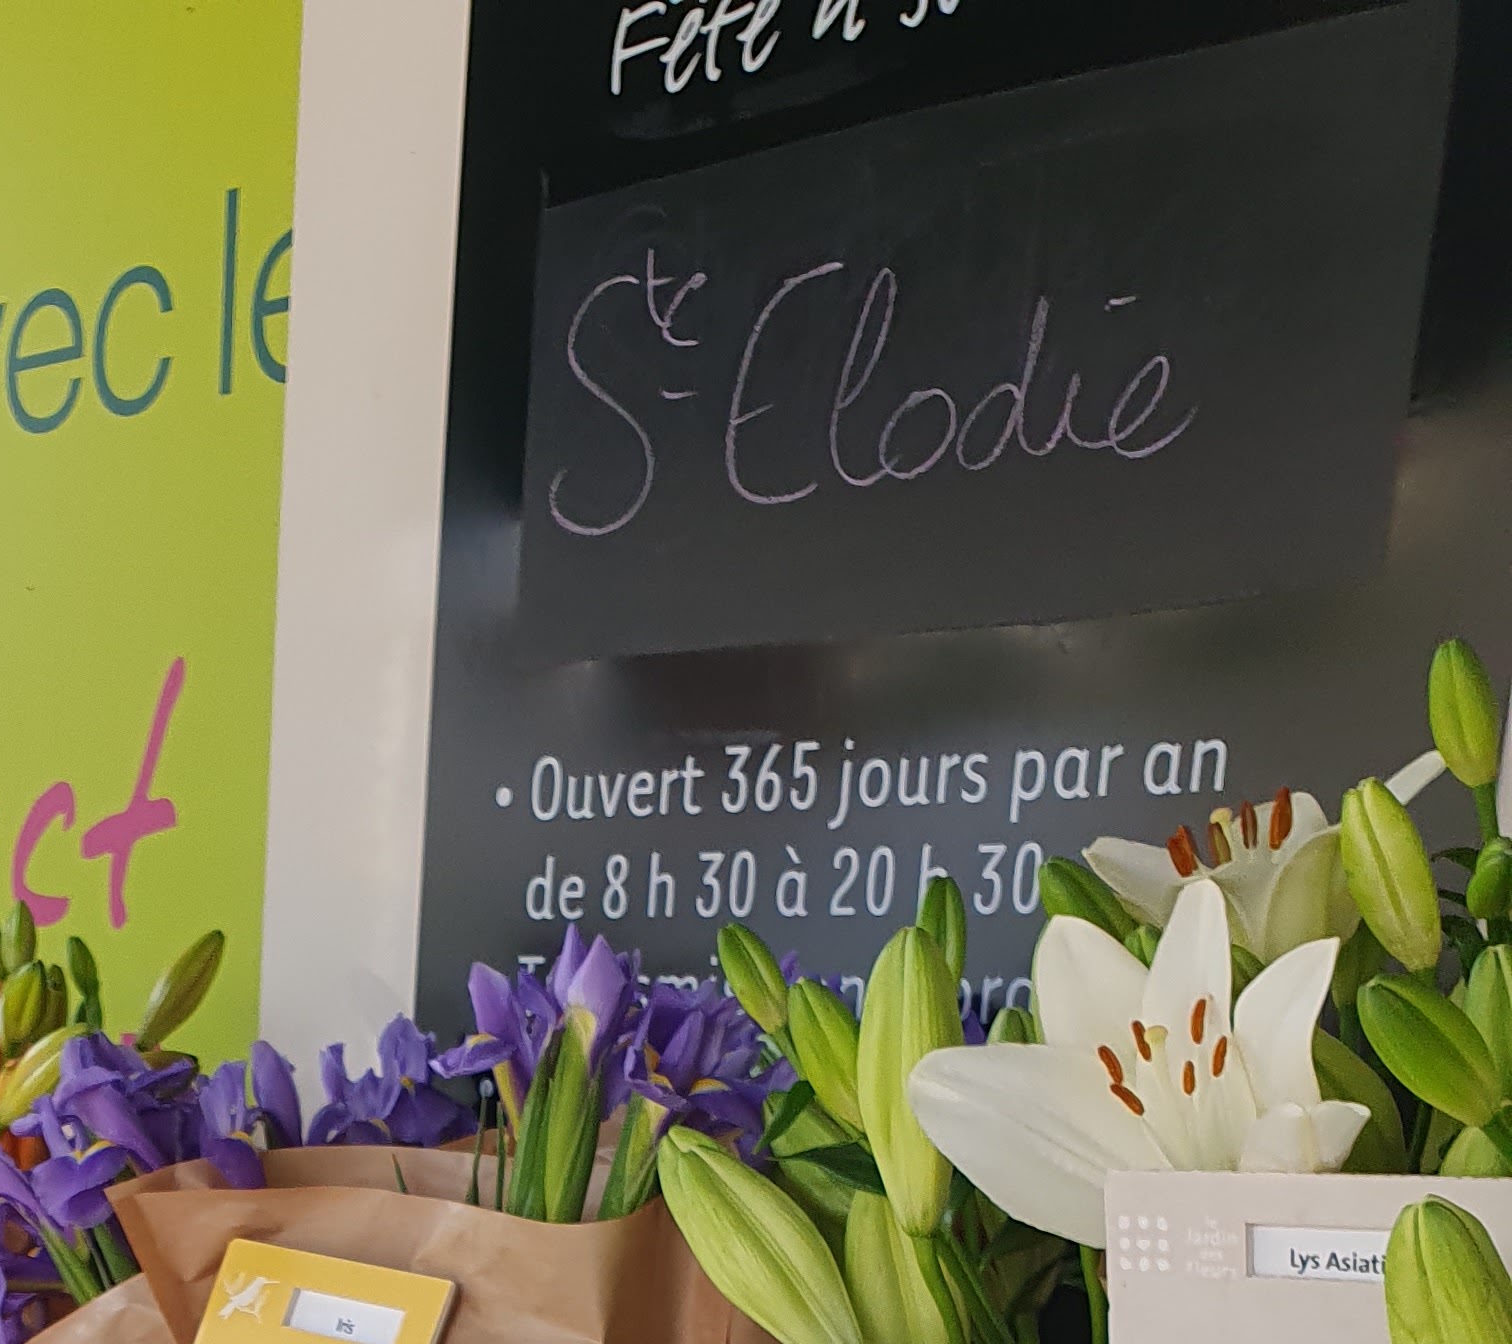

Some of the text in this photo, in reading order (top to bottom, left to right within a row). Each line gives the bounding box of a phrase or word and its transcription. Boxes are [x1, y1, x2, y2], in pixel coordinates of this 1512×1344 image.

[724, 261, 1199, 504] Elodie
[531, 737, 1229, 829] Ouvert 365 jours par an
[525, 856, 585, 921] de
[602, 854, 629, 920] 8
[648, 851, 676, 917] h
[695, 850, 757, 918] 30
[775, 843, 808, 917] à
[830, 845, 892, 916] 20
[973, 840, 1044, 915] 30
[1289, 1247, 1386, 1276] Lys Asiati
